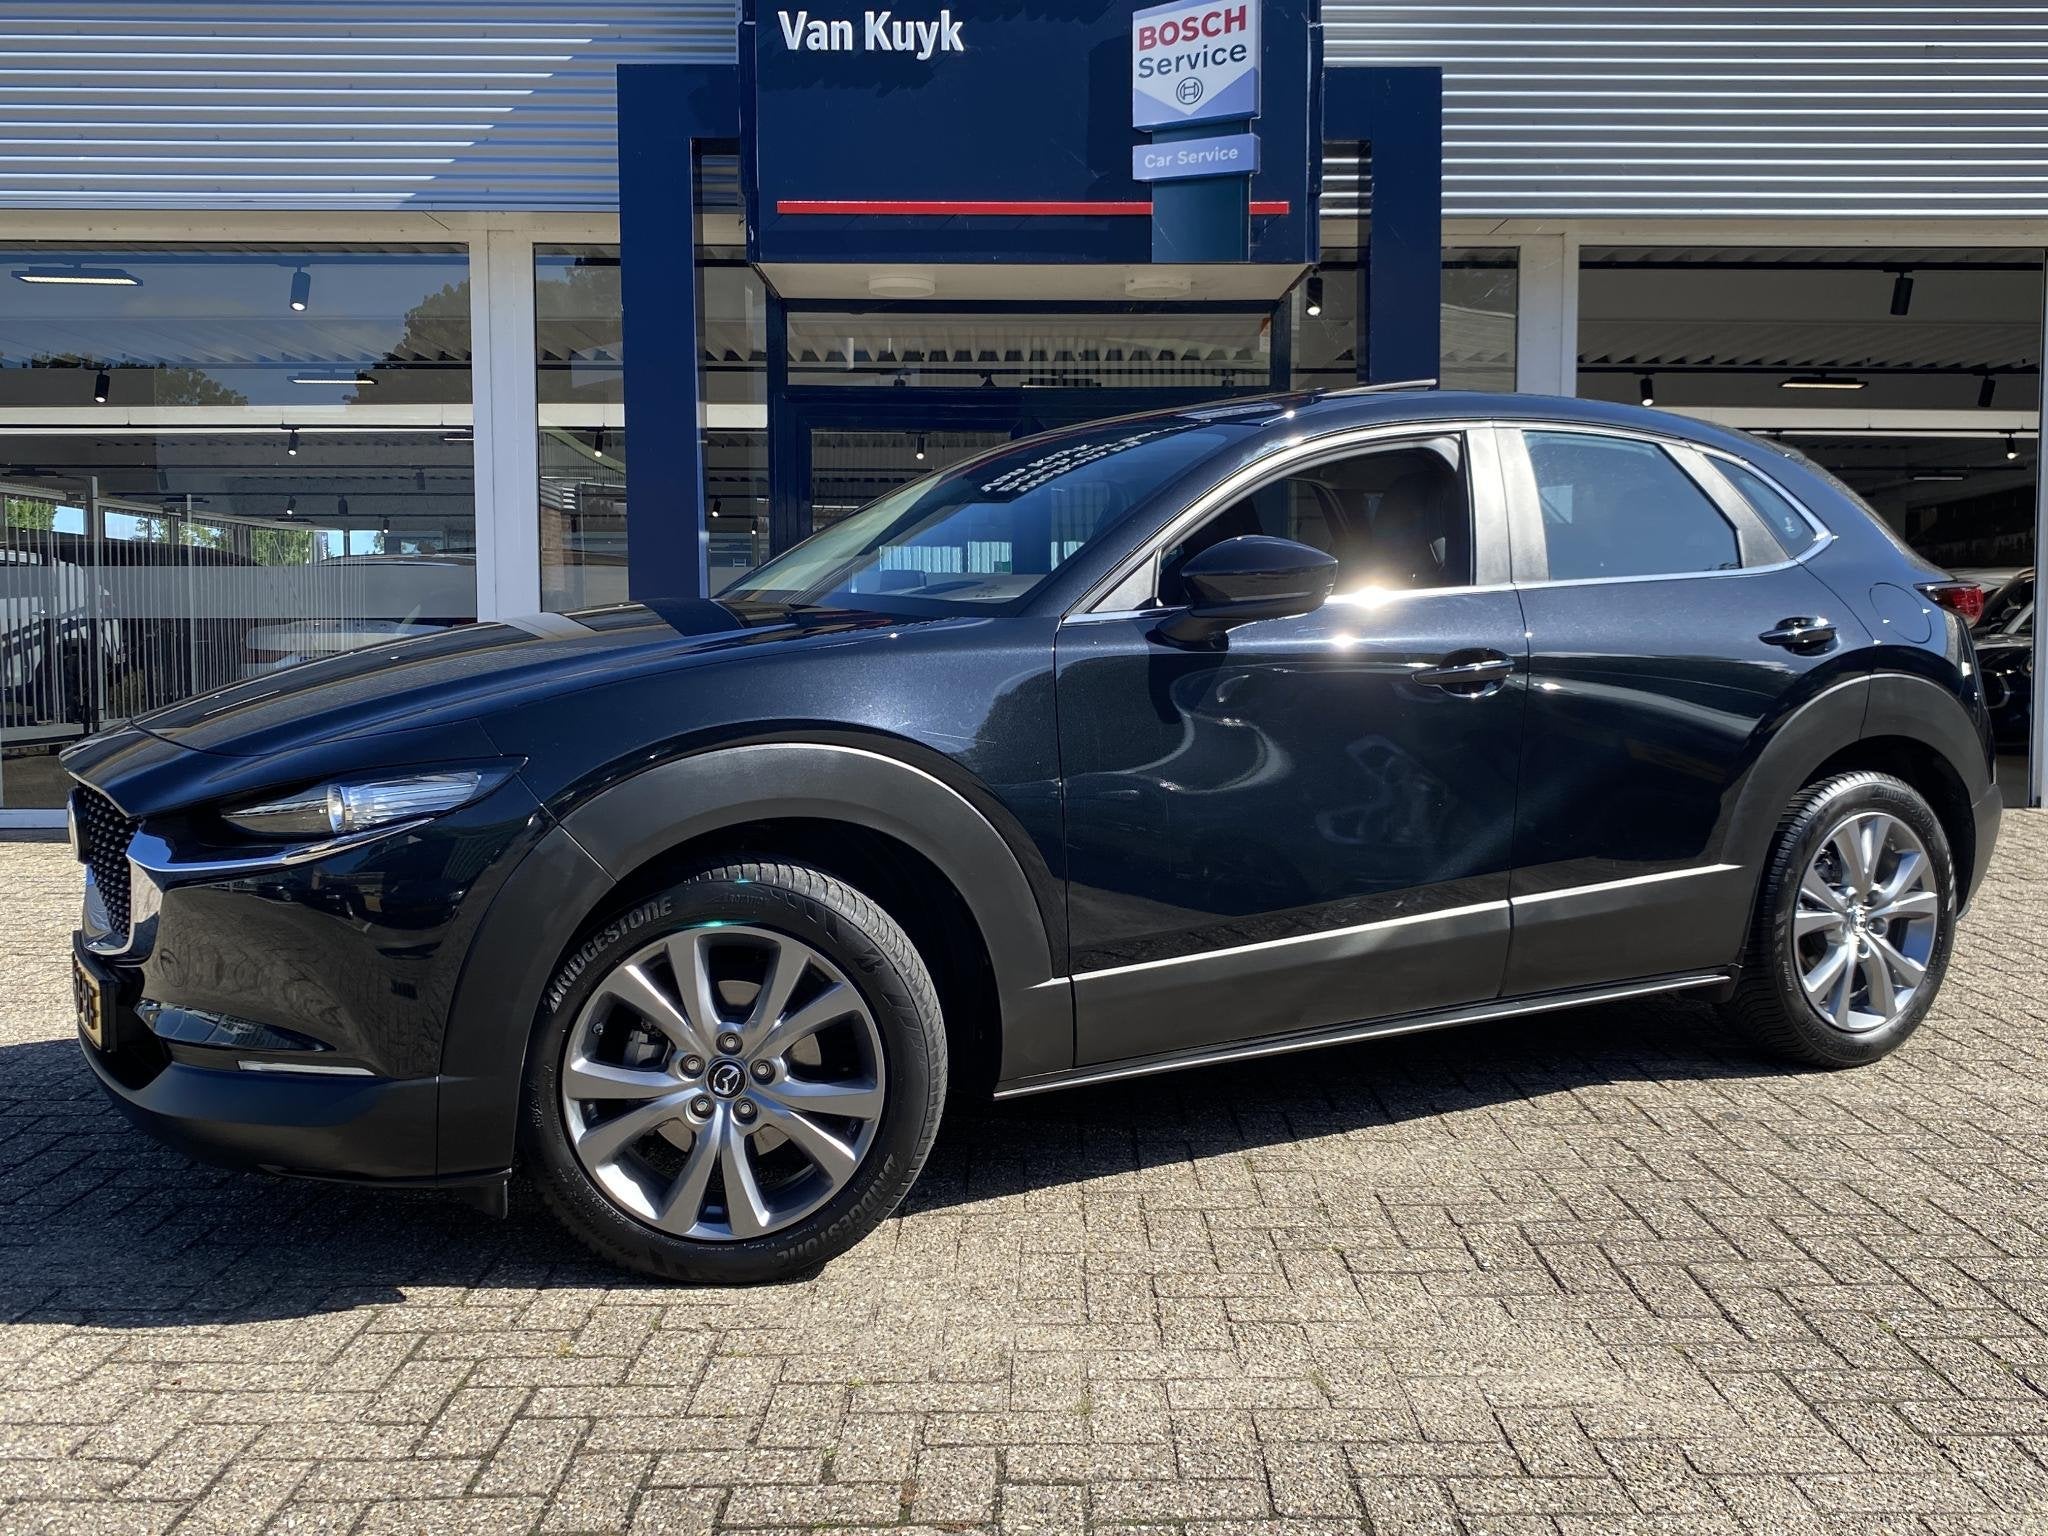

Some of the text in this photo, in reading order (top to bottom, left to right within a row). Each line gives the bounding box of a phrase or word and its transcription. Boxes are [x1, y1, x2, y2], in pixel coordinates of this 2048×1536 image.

[777, 10, 964, 61] Van Kuyk
[1138, 5, 1247, 51] BOSCH
[1138, 44, 1247, 79] Service
[1144, 147, 1239, 169] Car Service
[549, 896, 673, 1014] BRIDGESTONE
